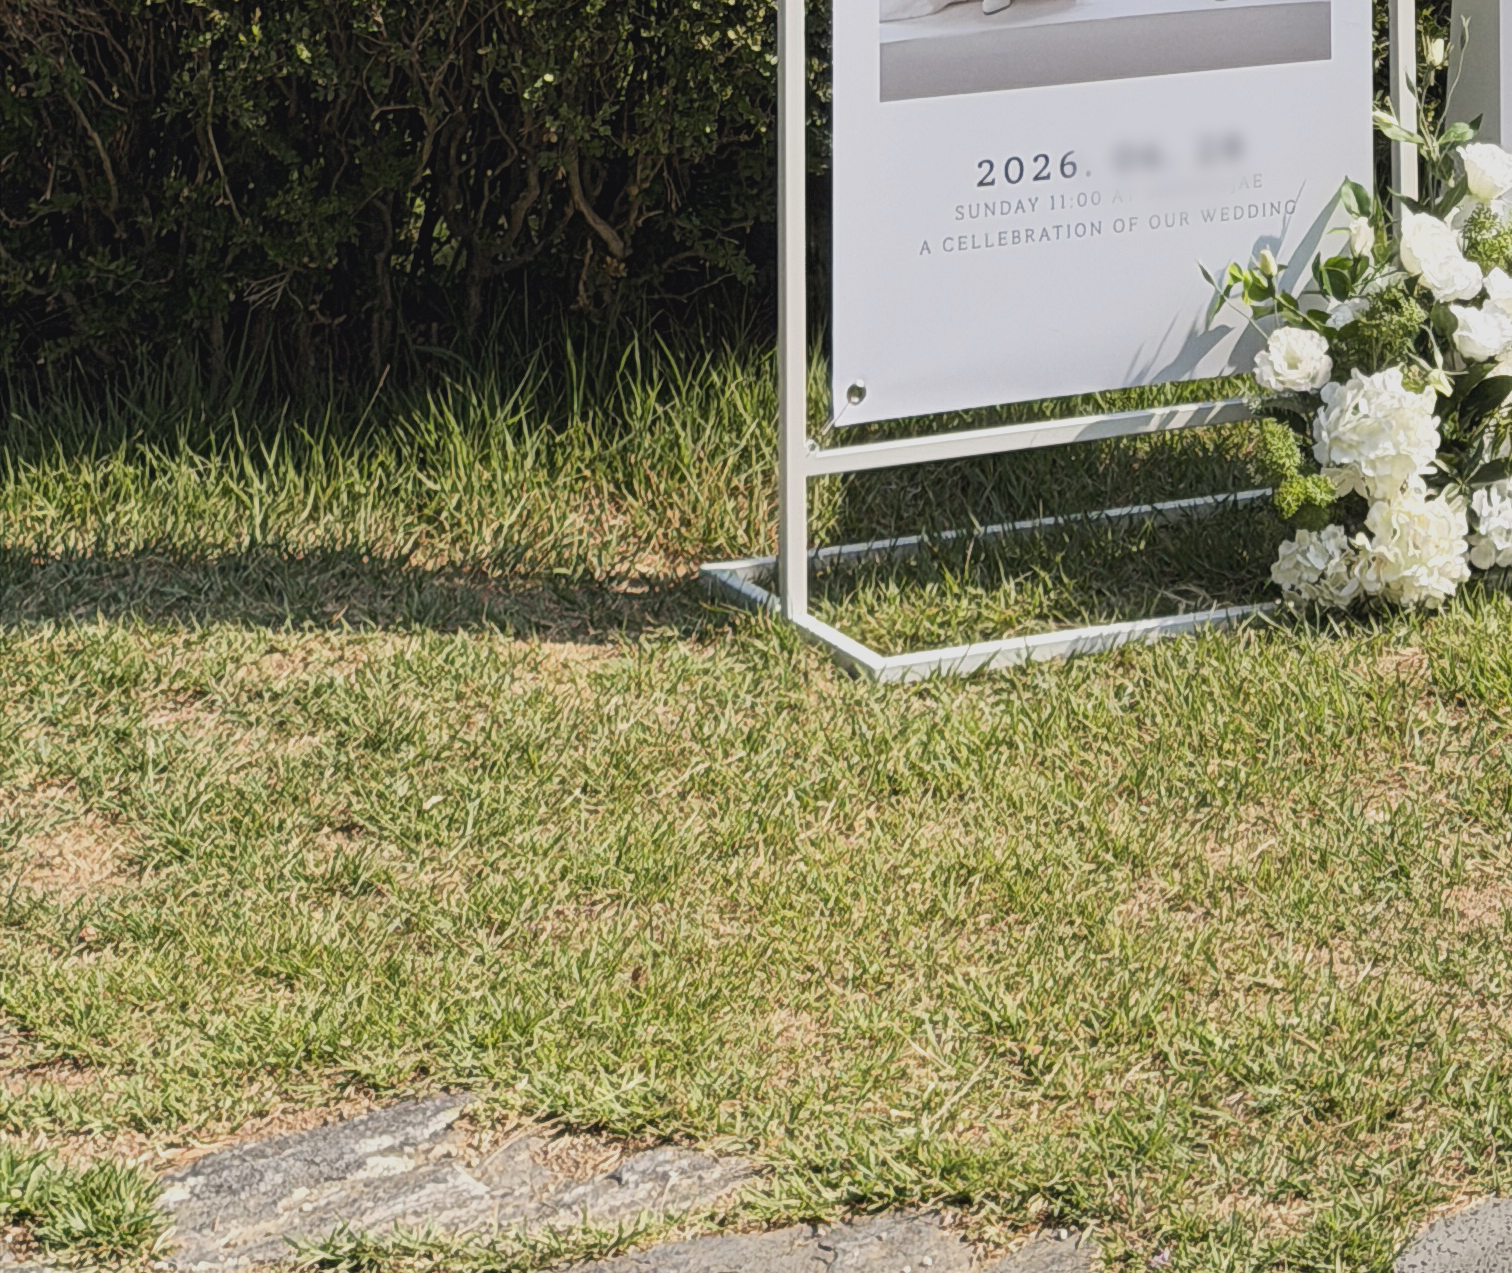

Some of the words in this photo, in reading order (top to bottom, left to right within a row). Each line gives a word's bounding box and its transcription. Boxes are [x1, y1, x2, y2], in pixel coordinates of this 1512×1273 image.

[954, 196, 1050, 221] SUNDAY
[1050, 190, 1102, 211] 11:00
[919, 240, 932, 255] A
[942, 220, 1103, 253] CELLEBRATION
[1112, 217, 1139, 234] OF
[1148, 212, 1190, 230] OUR
